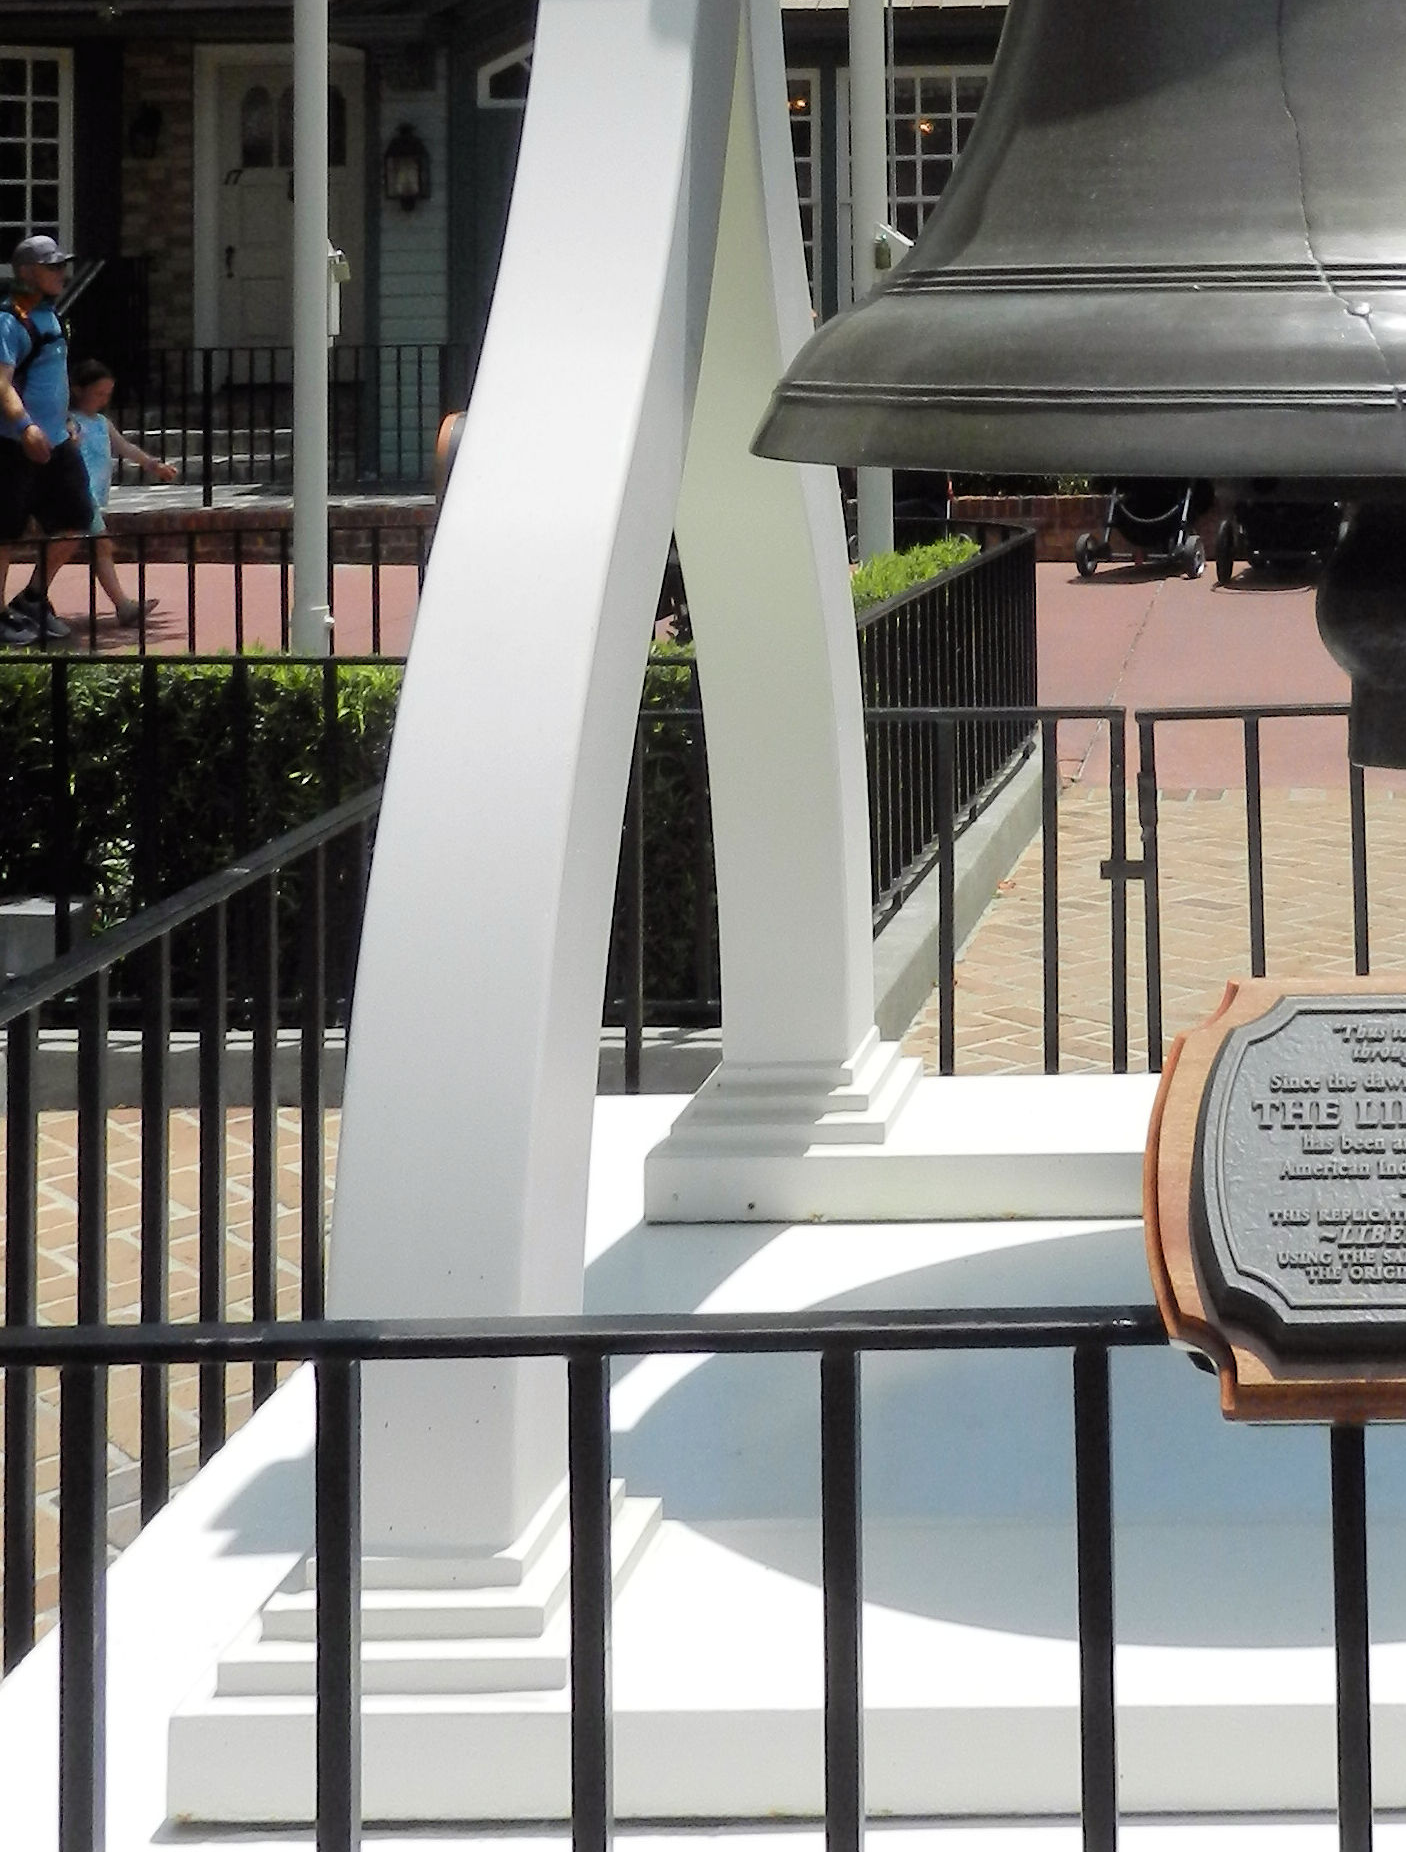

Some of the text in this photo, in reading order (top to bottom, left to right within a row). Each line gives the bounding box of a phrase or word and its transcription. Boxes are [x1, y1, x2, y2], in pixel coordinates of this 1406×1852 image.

[1270, 1073, 1321, 1093] Since
[1326, 1073, 1357, 1093] the
[1251, 1098, 1342, 1130] THE
[1302, 1133, 1334, 1154] has
[1340, 1132, 1387, 1154] been
[1279, 1159, 1371, 1181] American
[1268, 1208, 1311, 1226] THIS
[1276, 1250, 1334, 1269] USING
[1338, 1249, 1376, 1268] THE
[1305, 1266, 1343, 1285] THE
